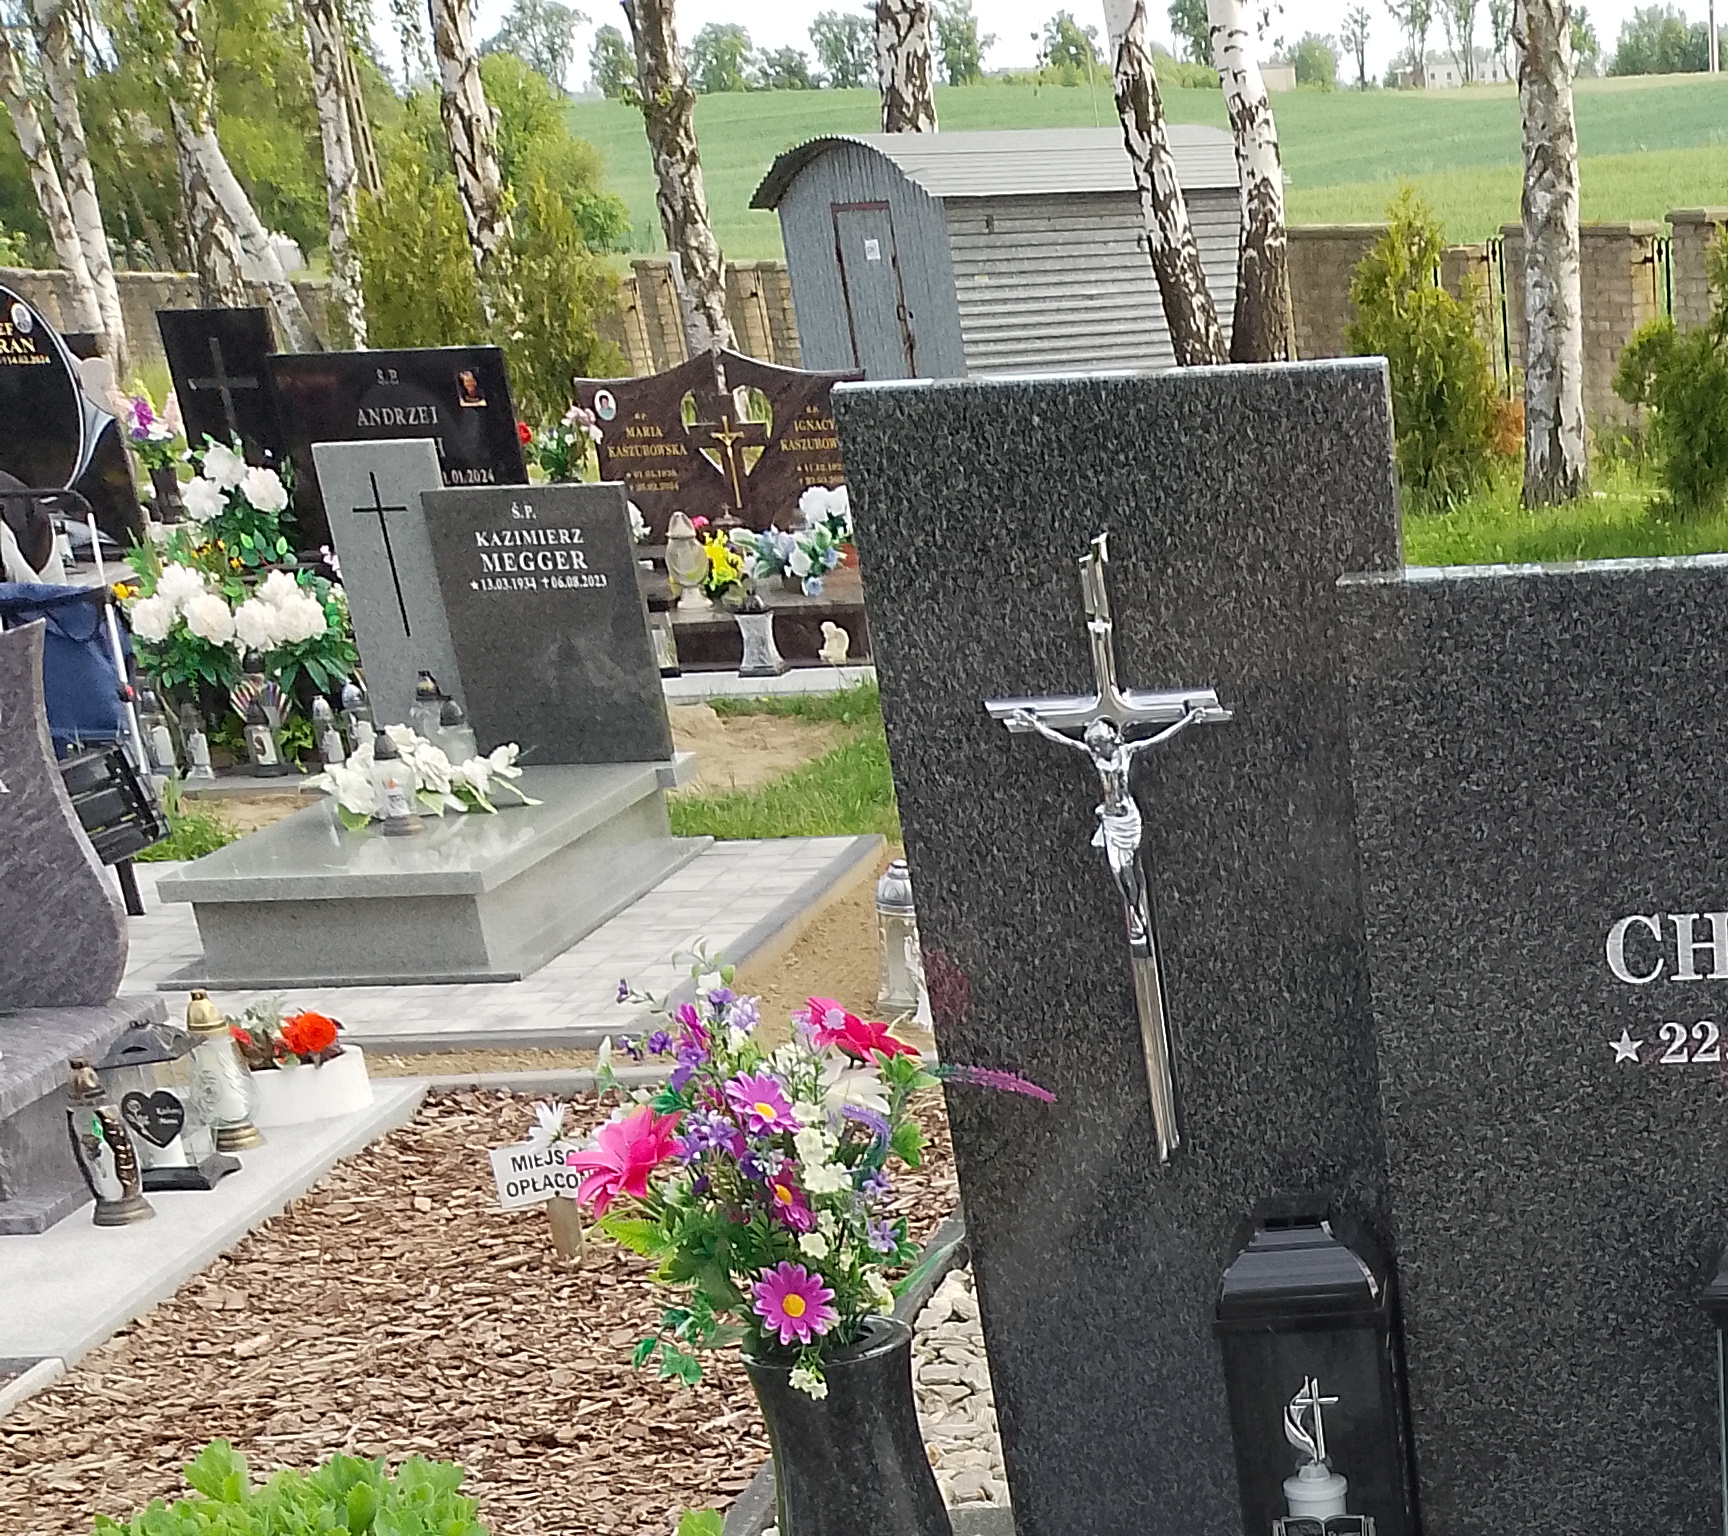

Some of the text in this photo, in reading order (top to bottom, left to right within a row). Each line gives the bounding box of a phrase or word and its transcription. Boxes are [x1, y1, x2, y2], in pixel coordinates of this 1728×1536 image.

[0, 322, 13, 336] EF
[0, 337, 36, 353] RAN
[357, 406, 439, 427] ANDRZEJ
[625, 425, 664, 438] MARIA
[794, 418, 836, 432] IGNACY
[607, 443, 688, 458] KASZUBOWSKA
[780, 437, 838, 452] KASZUBOW
[443, 468, 495, 485] 1.01.2024
[475, 529, 585, 547] KAZIMIERZ
[480, 550, 588, 573] MEGGER
[506, 1172, 582, 1198] OPŁACO
